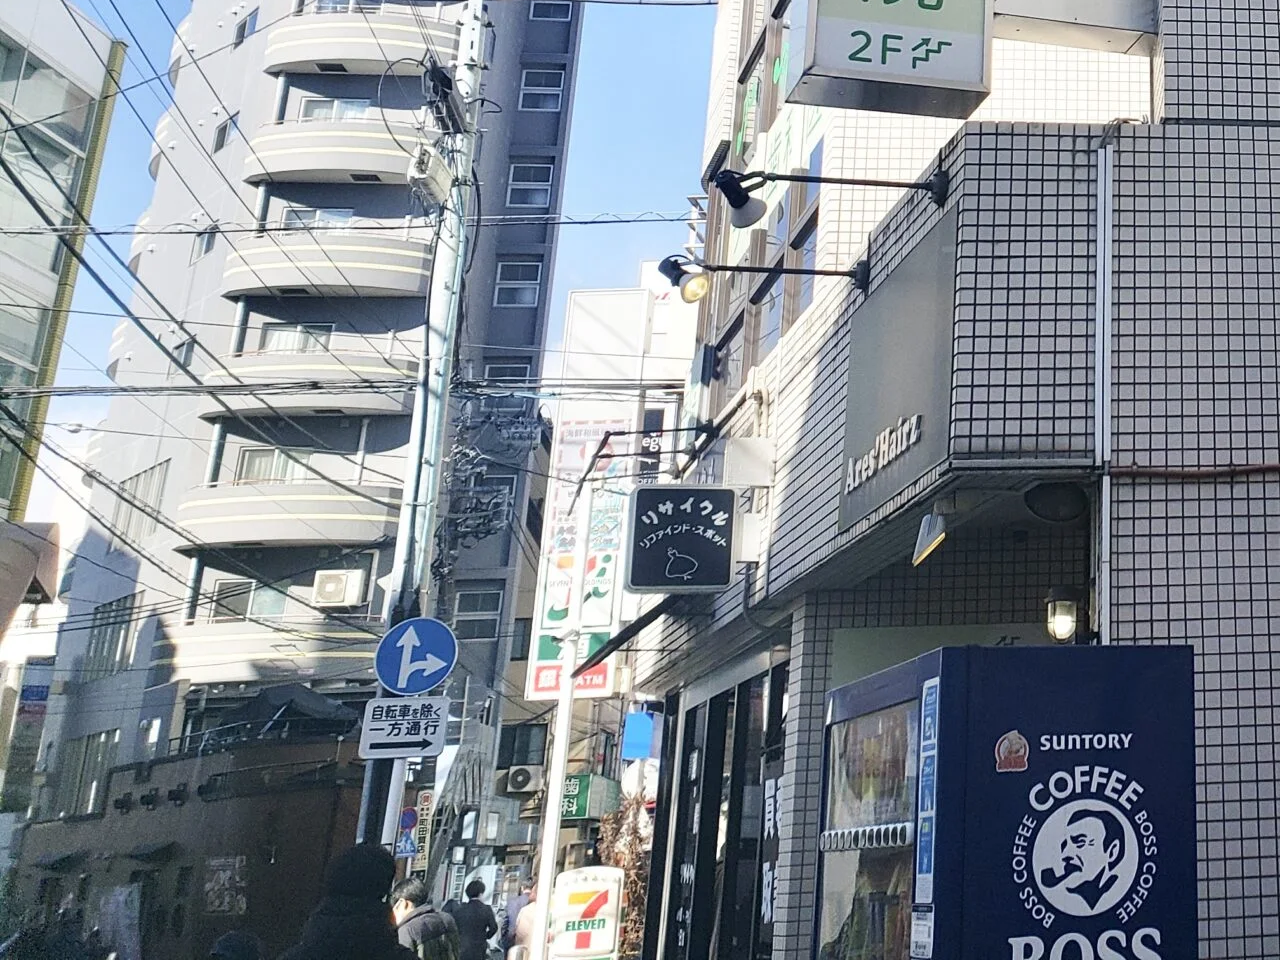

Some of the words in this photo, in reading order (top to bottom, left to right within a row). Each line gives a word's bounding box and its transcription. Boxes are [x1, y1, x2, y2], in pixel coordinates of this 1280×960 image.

[848, 30, 903, 66] 2F
[641, 497, 729, 526] リサイクル
[369, 720, 440, 737] 一方通行
[371, 703, 441, 720] 自転車を除く
[1029, 765, 1144, 811] COFFEE
[1012, 814, 1037, 884] COFFEE
[1134, 810, 1157, 856] BOSS
[1019, 887, 1055, 929] BOSS
[1116, 861, 1157, 924] COFFEE
